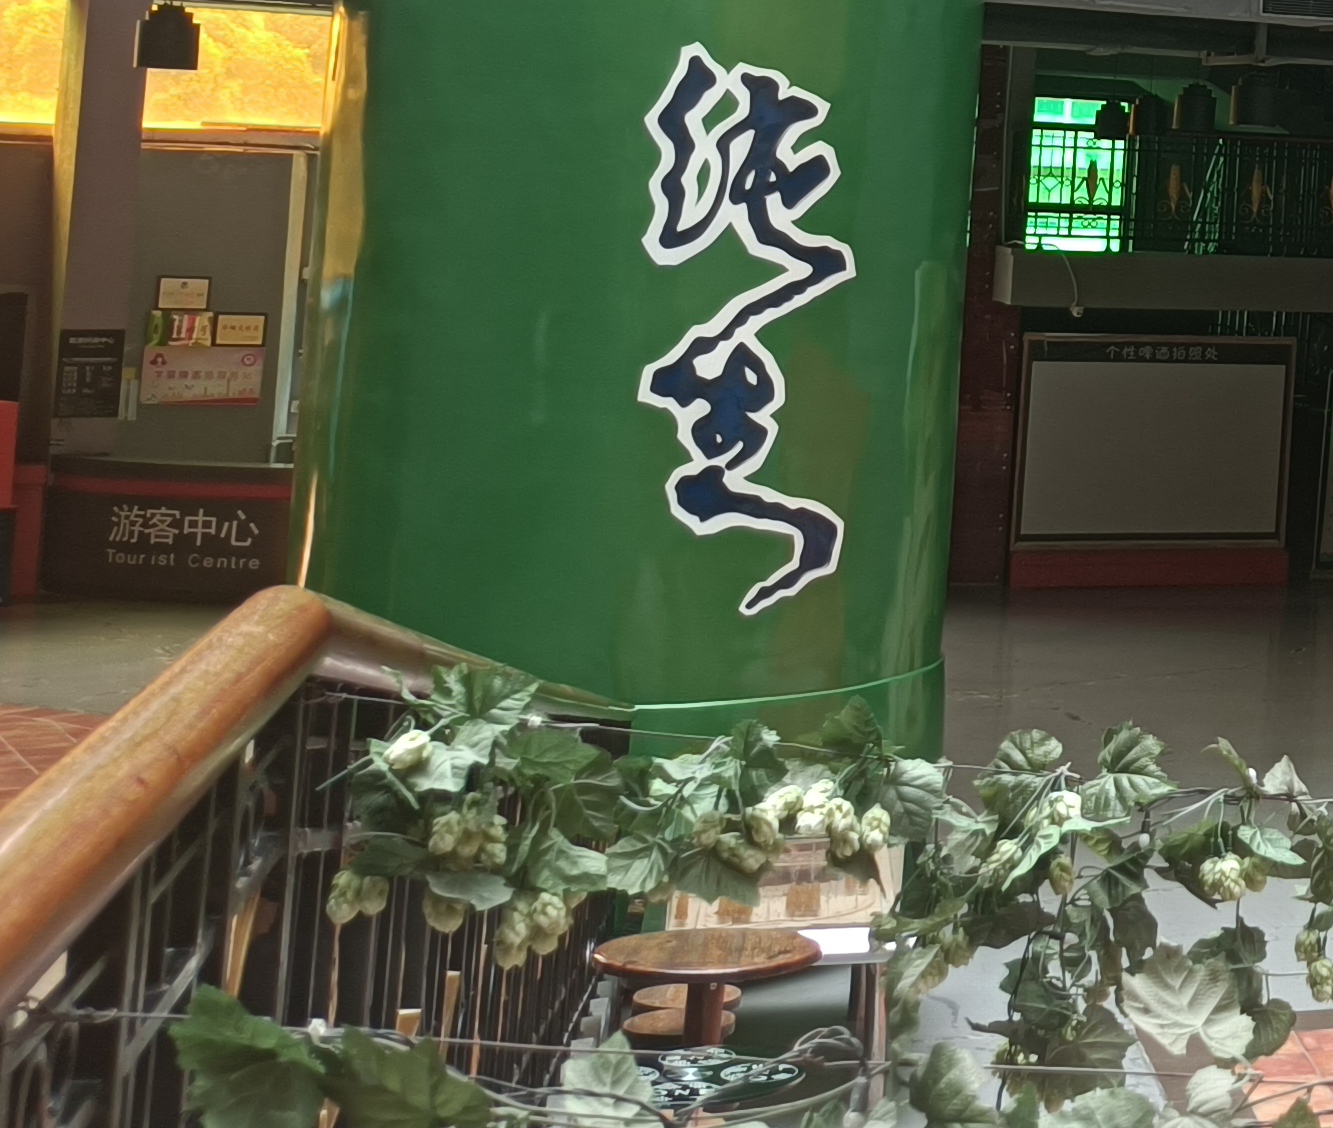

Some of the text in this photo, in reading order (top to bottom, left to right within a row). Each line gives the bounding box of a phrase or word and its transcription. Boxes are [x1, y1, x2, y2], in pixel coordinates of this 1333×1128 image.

[1105, 345, 1219, 361] 个性啤酒拍照处
[108, 504, 260, 547] 游客中心
[106, 548, 260, 570] Tourist Centre
